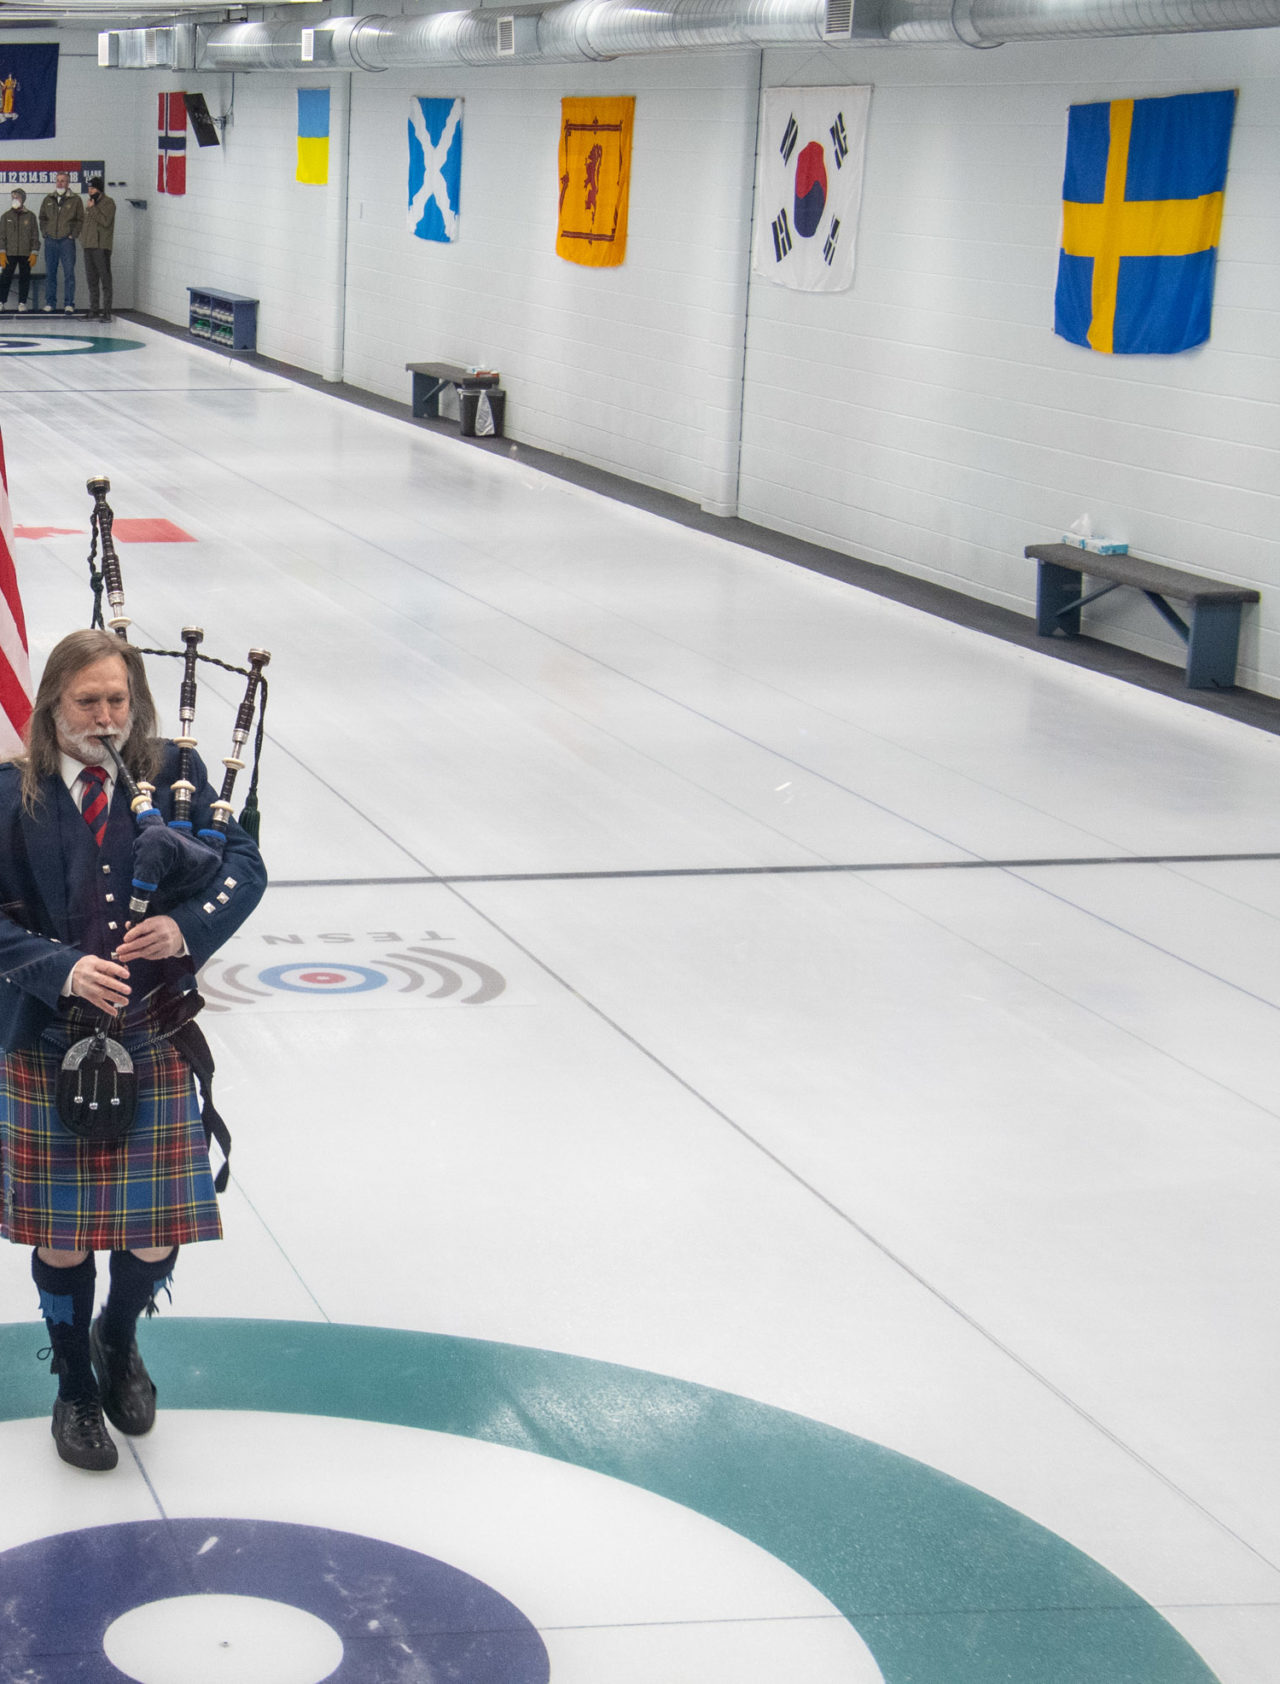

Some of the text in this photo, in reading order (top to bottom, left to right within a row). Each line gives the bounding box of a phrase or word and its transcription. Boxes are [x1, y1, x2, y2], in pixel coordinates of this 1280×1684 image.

[0, 171, 7, 183] 11
[8, 171, 17, 183] 12
[19, 171, 27, 183] 13
[29, 171, 38, 183] 14
[39, 171, 48, 183] 15
[69, 171, 78, 183] 18
